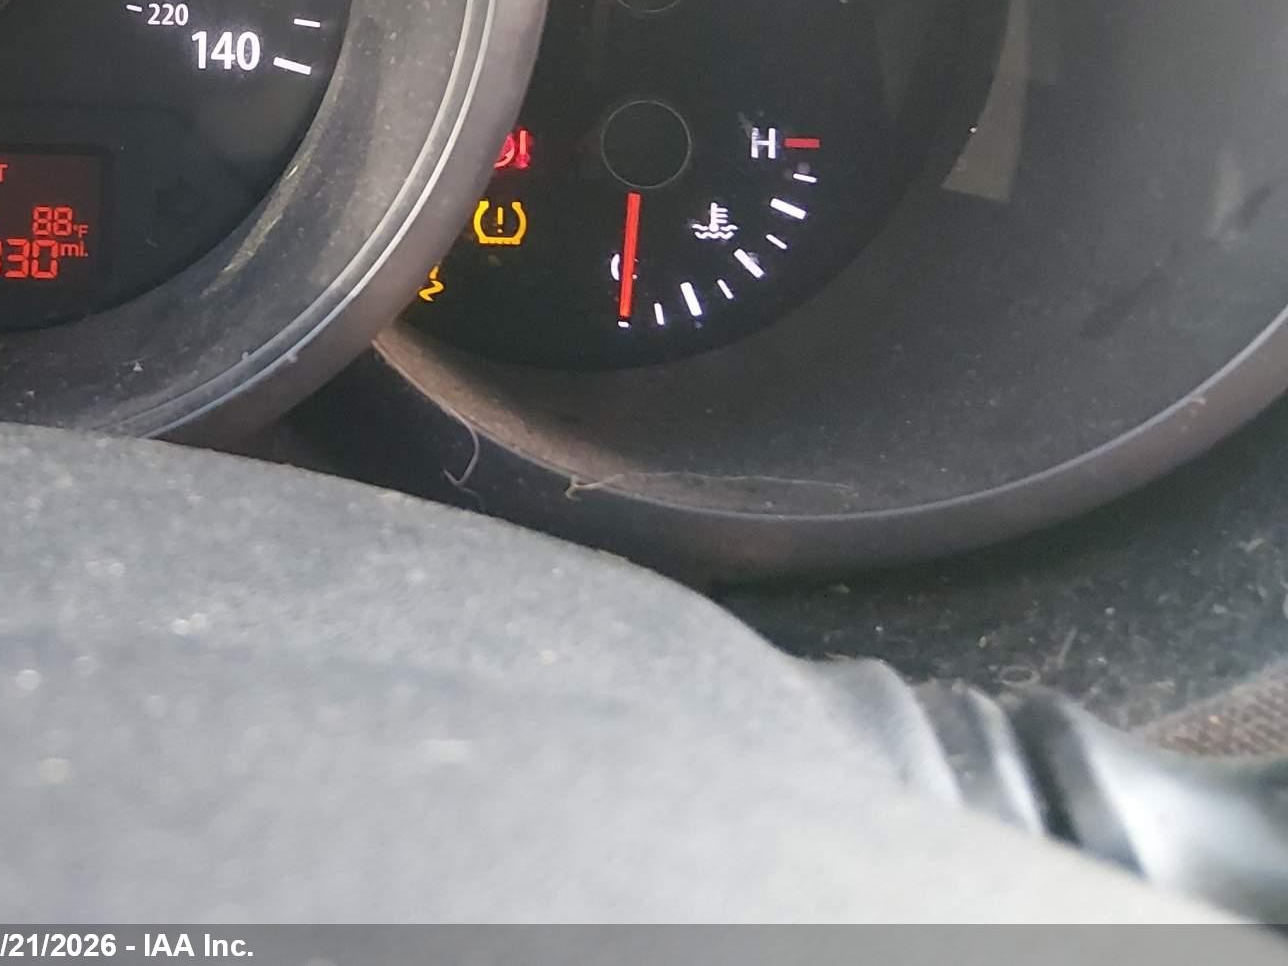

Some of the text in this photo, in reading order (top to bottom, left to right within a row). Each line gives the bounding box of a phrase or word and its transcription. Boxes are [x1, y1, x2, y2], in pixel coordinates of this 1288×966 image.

[148, 3, 188, 26] 220
[192, 30, 260, 70] 140
[751, 128, 776, 158] H
